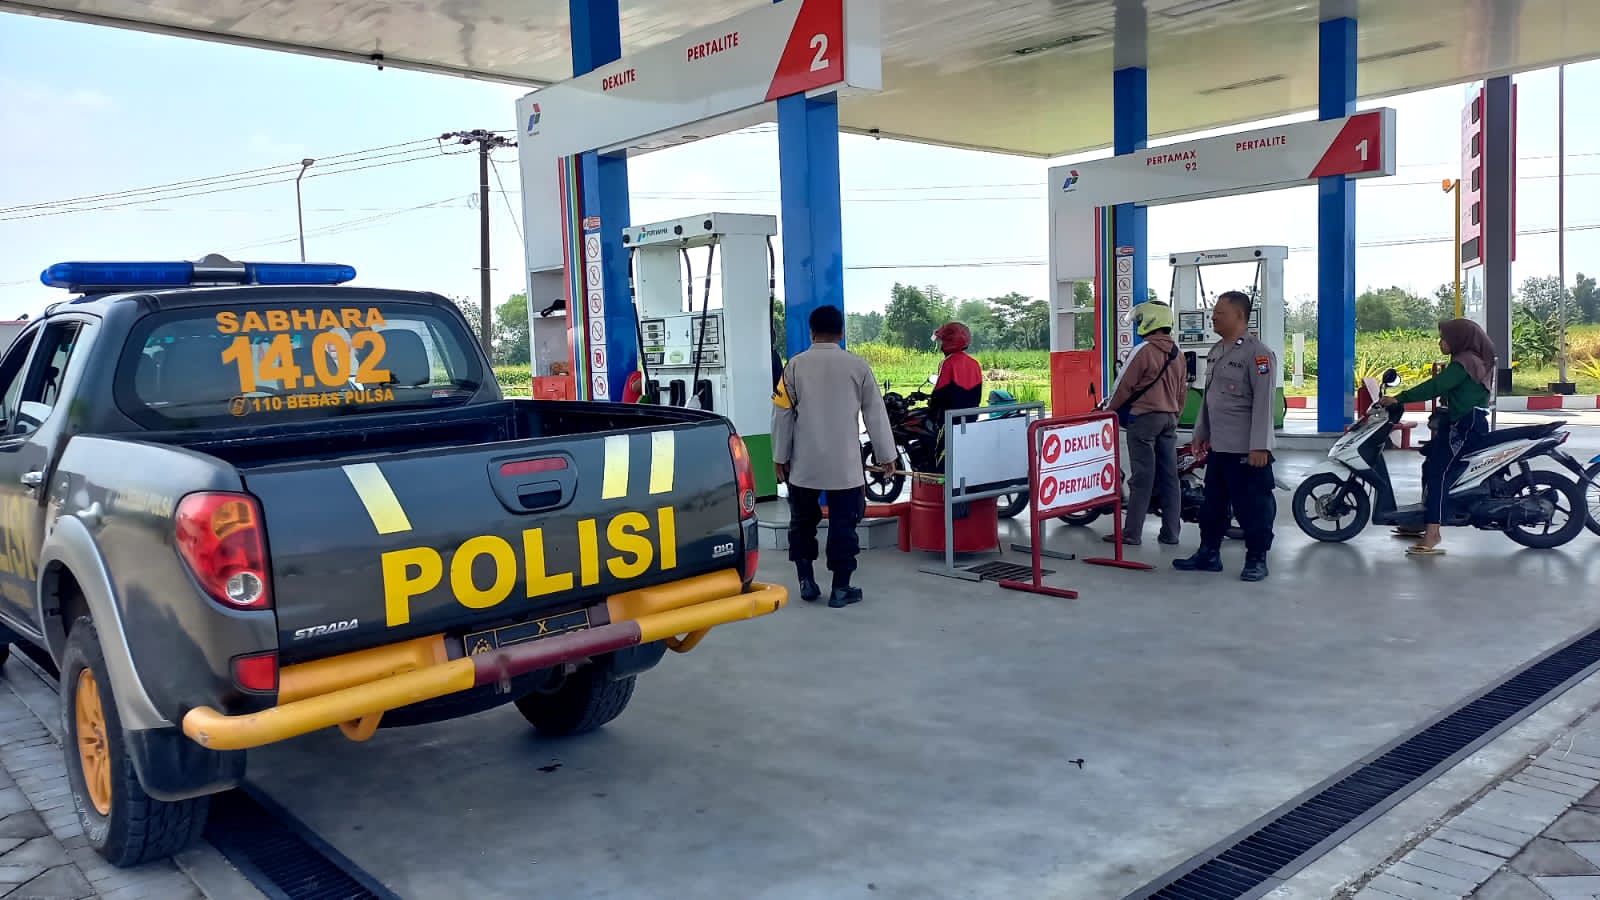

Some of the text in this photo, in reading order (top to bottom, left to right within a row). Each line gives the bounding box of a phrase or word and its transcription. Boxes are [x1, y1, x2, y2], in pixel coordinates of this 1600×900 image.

[687, 31, 739, 62] PERTALITE
[810, 33, 829, 72] 2
[602, 68, 636, 91] DEXLITE
[1236, 135, 1287, 152] PERTALITE
[1354, 139, 1368, 161] 1
[1146, 149, 1197, 166] PERTAMAX
[1185, 162, 1197, 172] 92
[216, 308, 387, 334] SABHARA
[221, 331, 391, 393] 14.02
[252, 388, 395, 412] 110 BEBAS PULSA
[1064, 433, 1100, 454] DEXLITE
[1058, 472, 1101, 495] PERTALITE
[381, 506, 677, 628] POLISI
[293, 618, 359, 641] STRADA
